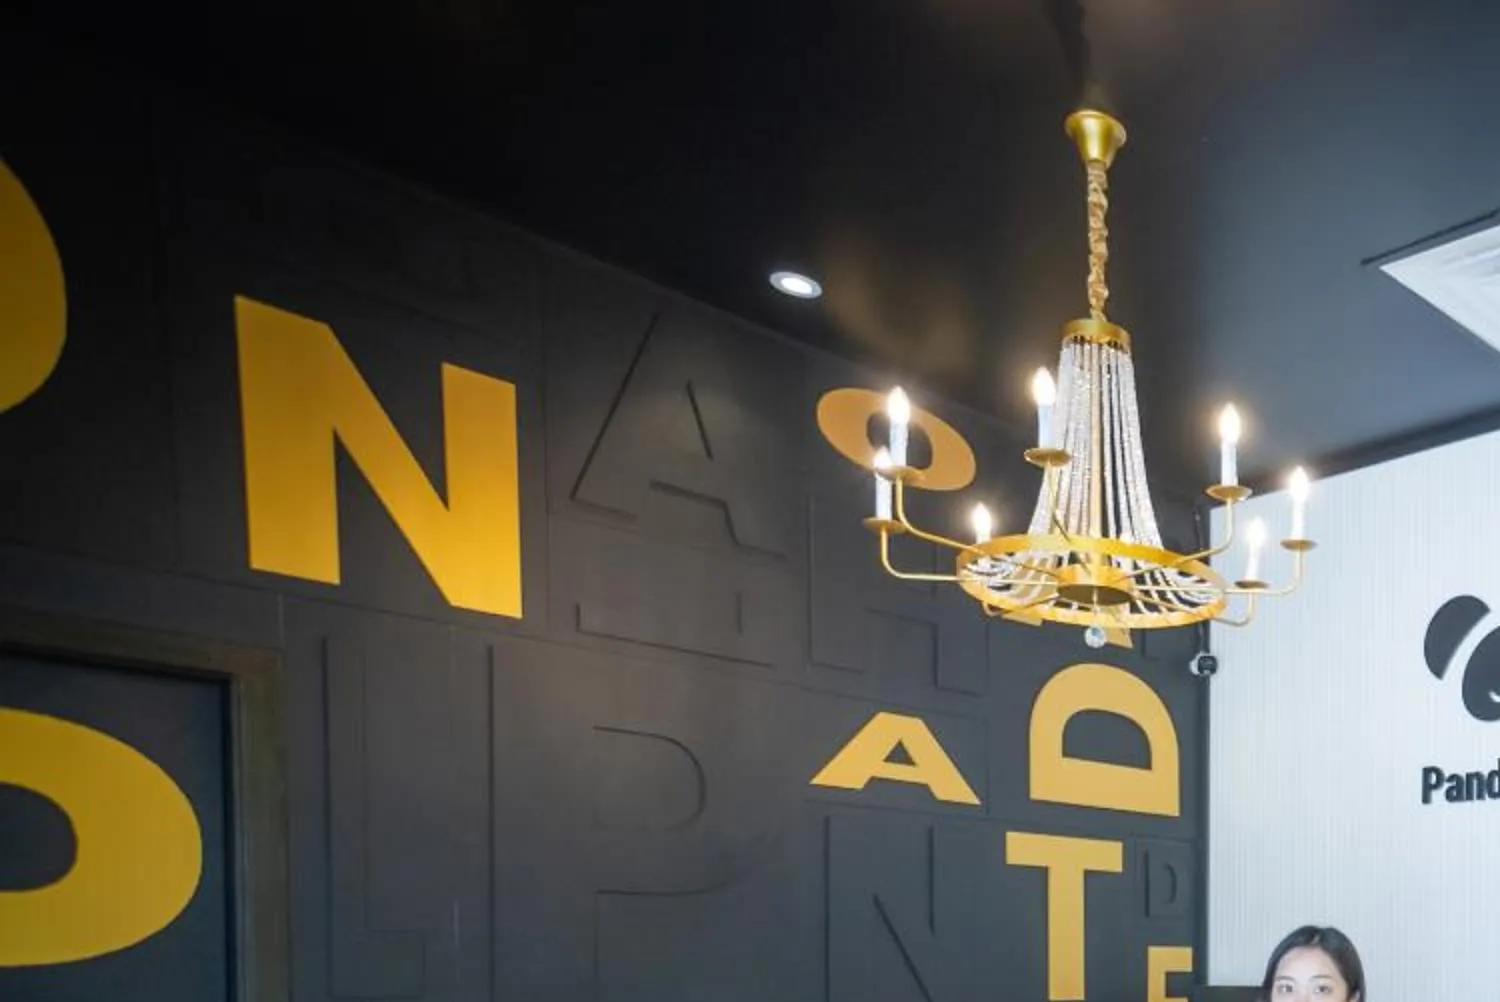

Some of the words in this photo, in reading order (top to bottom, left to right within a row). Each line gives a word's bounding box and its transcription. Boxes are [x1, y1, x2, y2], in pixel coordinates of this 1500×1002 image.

[234, 295, 523, 619] N
[810, 711, 981, 805] A
[1005, 831, 1123, 1001] T
